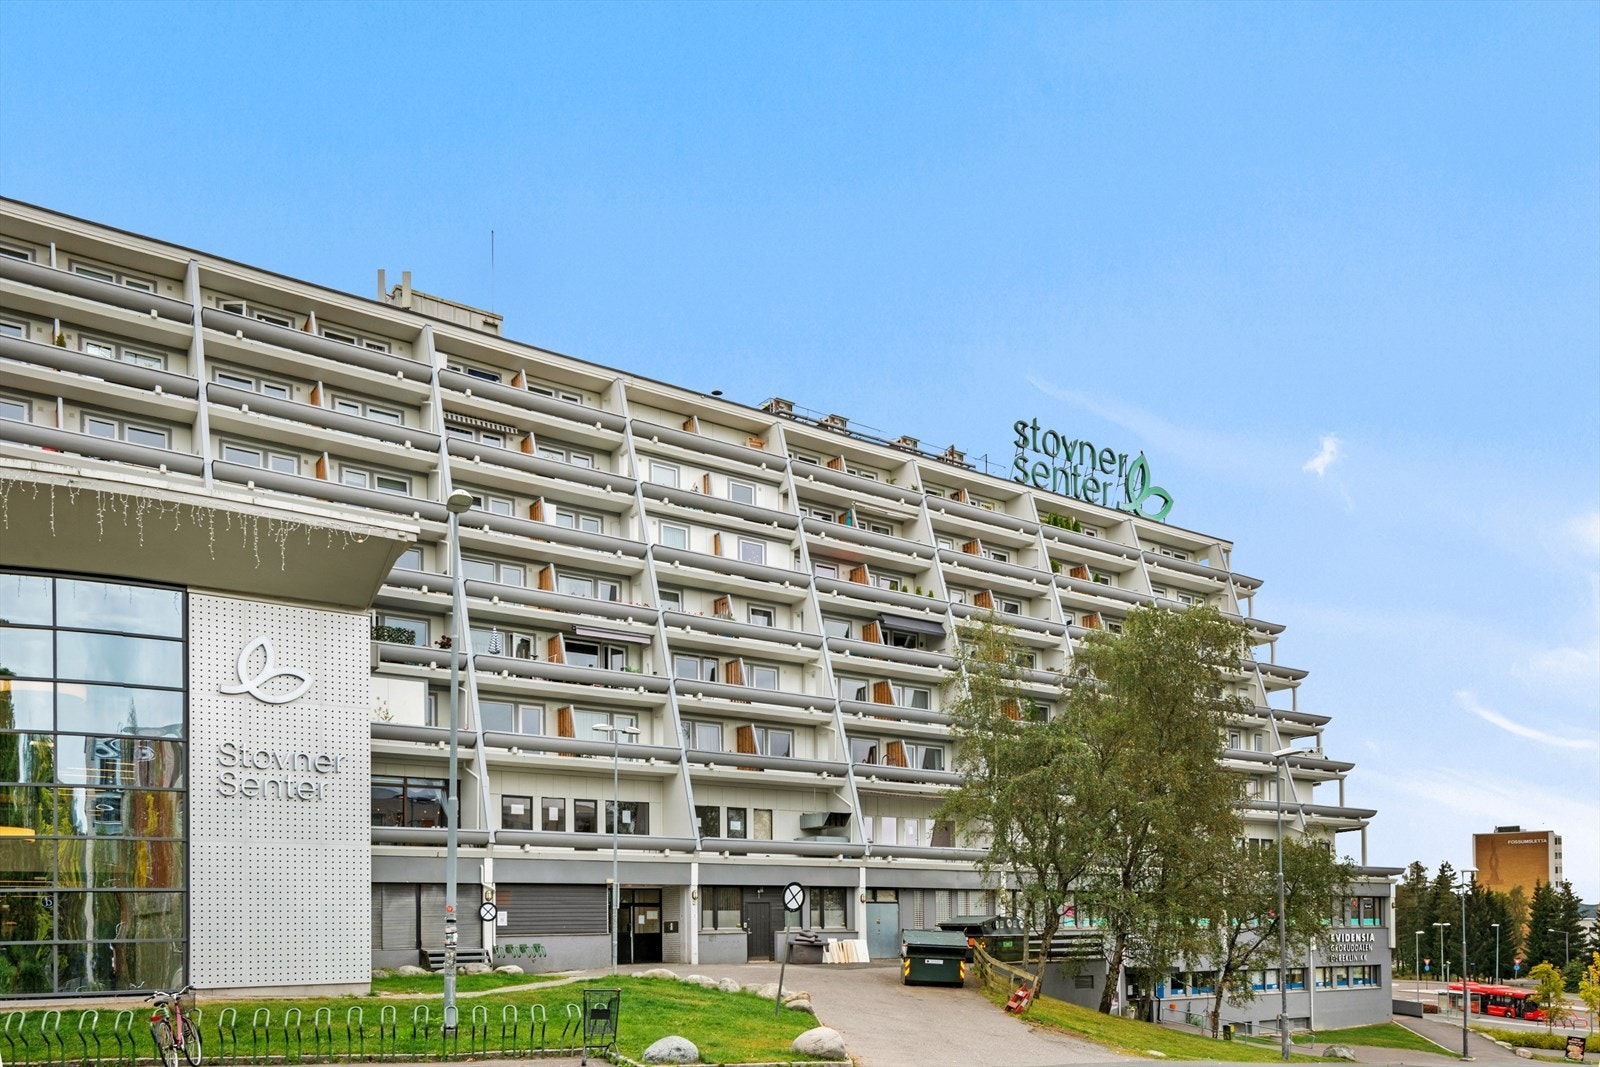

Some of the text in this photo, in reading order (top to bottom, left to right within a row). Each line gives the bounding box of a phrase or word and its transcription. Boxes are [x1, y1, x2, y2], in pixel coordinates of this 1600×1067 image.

[1013, 416, 1128, 478] stovner
[1013, 455, 1113, 506] senter
[218, 742, 345, 774] Stovner
[218, 771, 329, 801] Senter
[1330, 932, 1375, 942] EVIDENSIA
